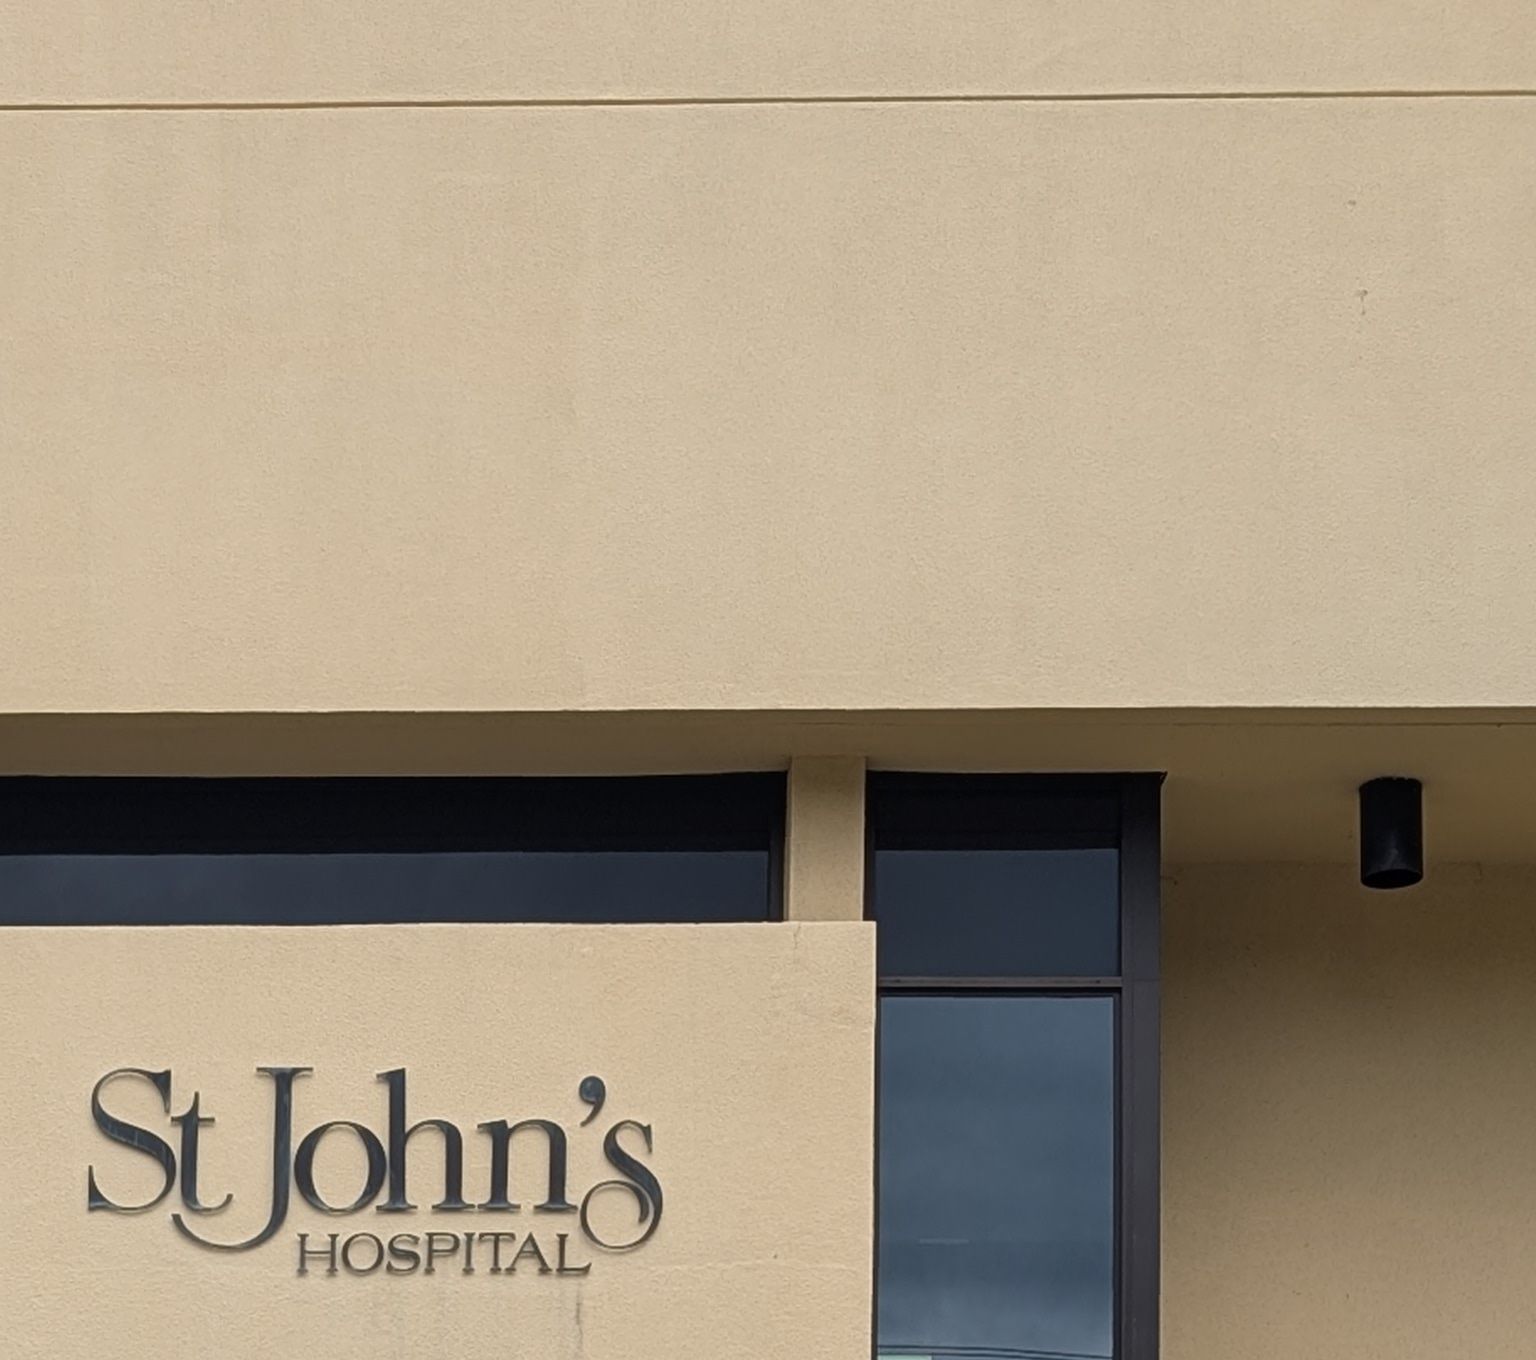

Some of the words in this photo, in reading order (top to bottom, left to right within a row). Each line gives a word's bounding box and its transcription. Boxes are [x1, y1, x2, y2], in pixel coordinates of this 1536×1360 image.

[87, 1067, 234, 1214] St
[171, 1066, 664, 1252] John's
[296, 1231, 592, 1277] HOSPITAL
